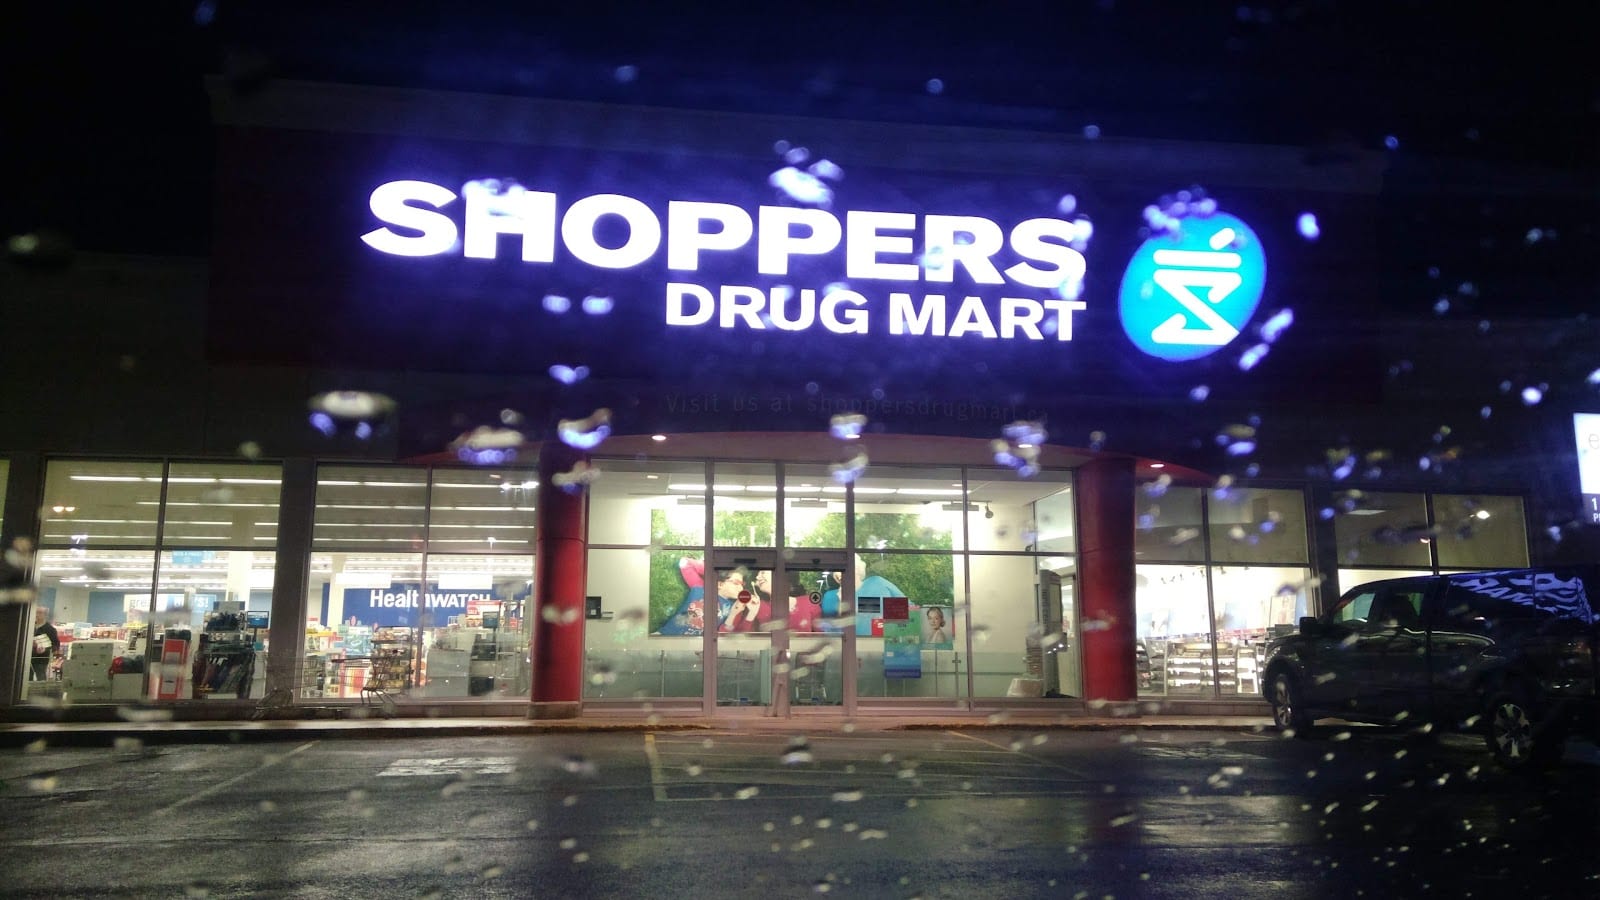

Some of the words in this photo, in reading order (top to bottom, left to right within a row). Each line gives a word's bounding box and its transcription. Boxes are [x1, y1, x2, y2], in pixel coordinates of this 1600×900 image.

[361, 179, 1088, 297] SHOPPERS
[665, 282, 869, 336] DRUG
[888, 292, 1087, 341] MART
[664, 391, 721, 413] Visit
[732, 394, 760, 413] us
[769, 393, 793, 414] at
[807, 392, 1049, 421] shoppersdrugmartca
